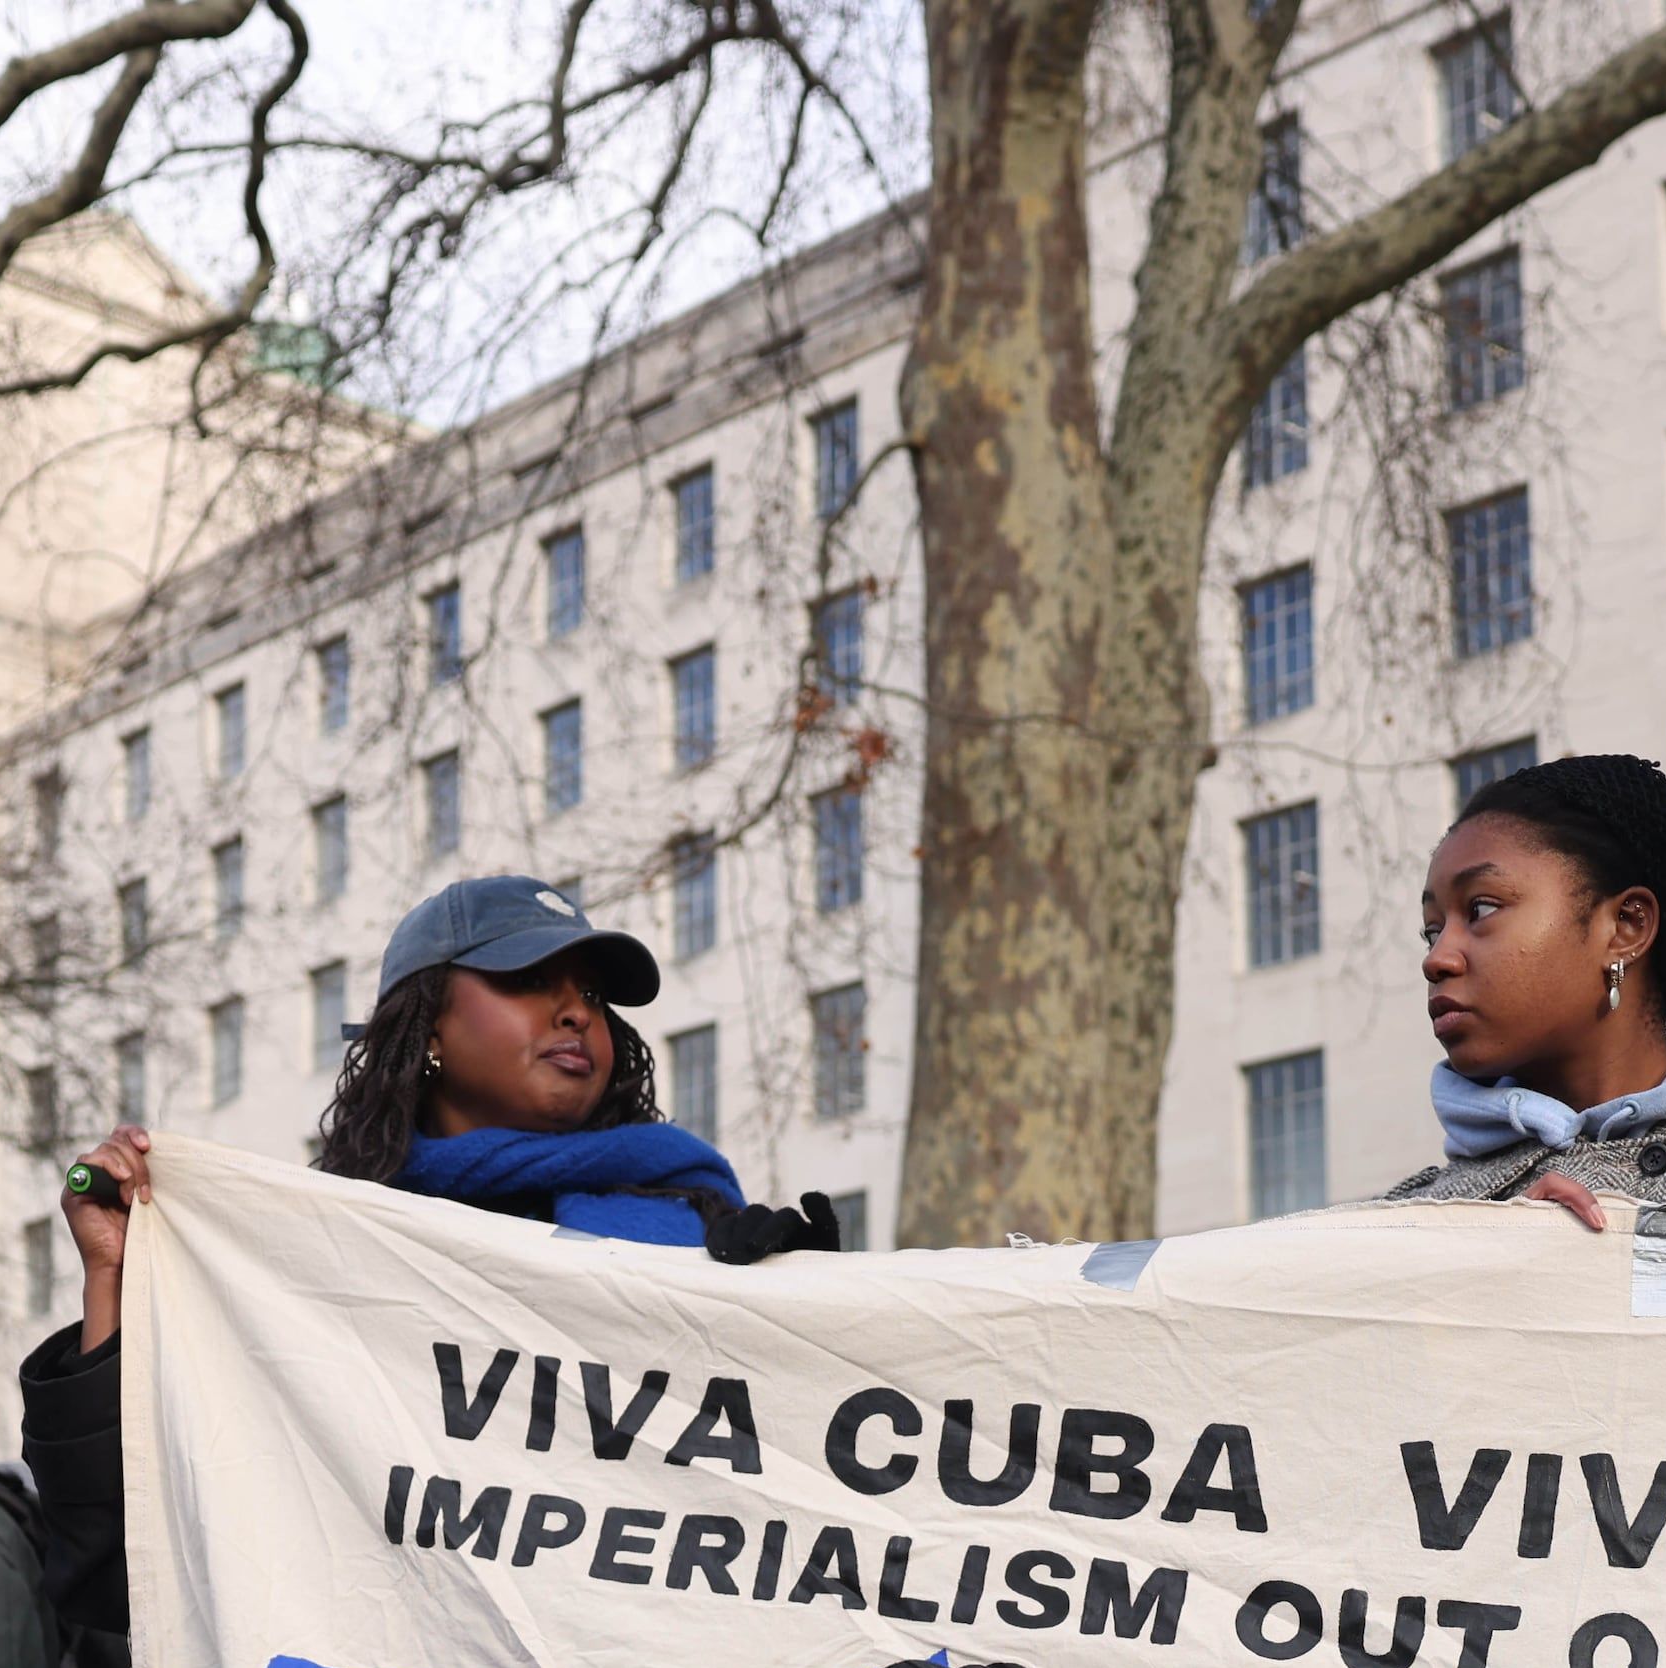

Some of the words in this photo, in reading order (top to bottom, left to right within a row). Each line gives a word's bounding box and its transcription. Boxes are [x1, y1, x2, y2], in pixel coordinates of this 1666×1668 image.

[432, 1341, 763, 1475] VIVA
[823, 1386, 1269, 1534] CUBA
[383, 1464, 1189, 1646] IMPERIALISM
